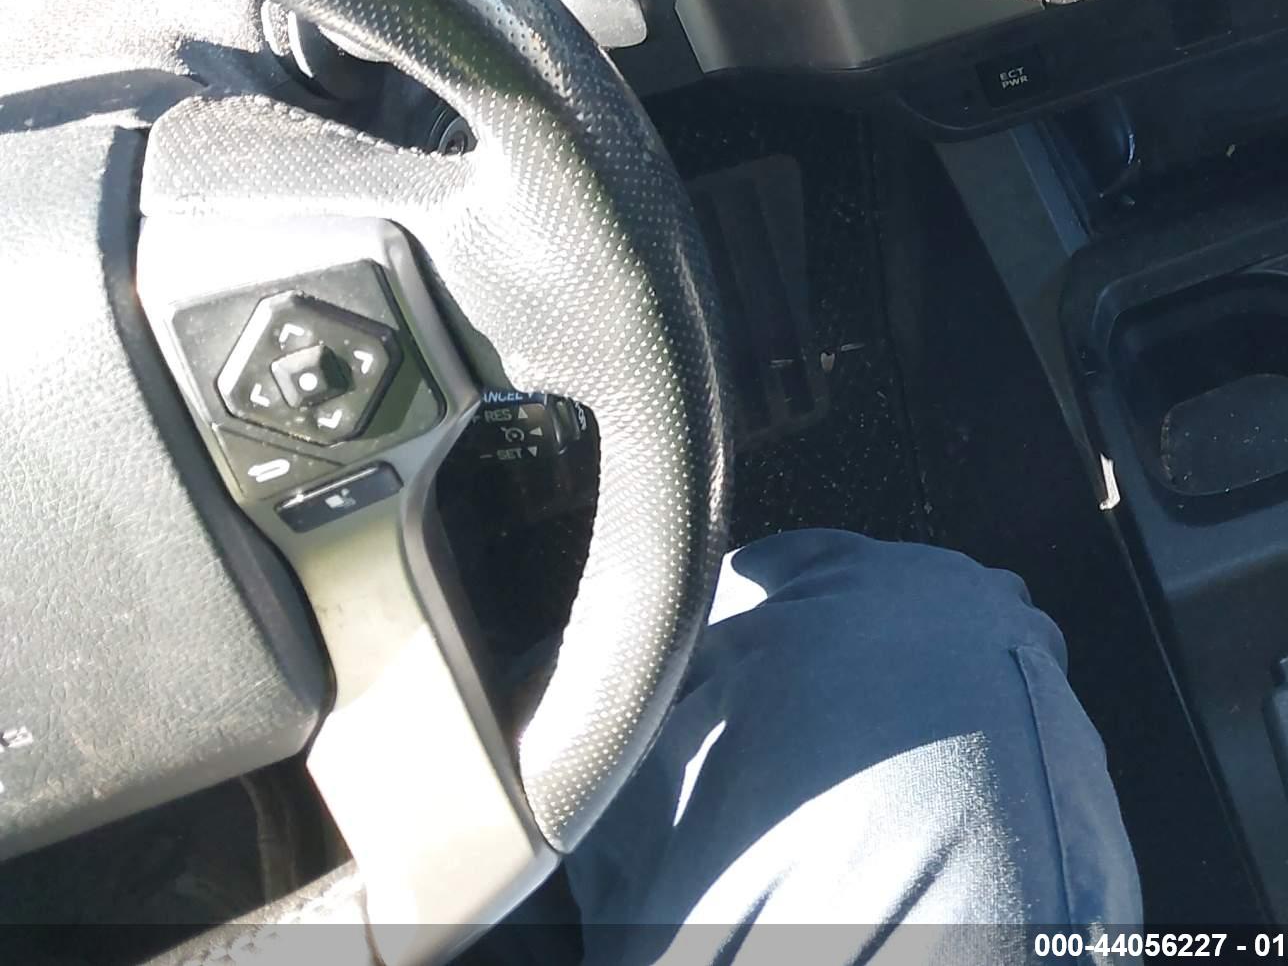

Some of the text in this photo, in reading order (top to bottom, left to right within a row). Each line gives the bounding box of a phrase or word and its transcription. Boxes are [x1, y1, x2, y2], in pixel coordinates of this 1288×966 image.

[1000, 66, 1024, 81] ECT
[1002, 75, 1028, 89] PWR
[484, 408, 513, 423] RES
